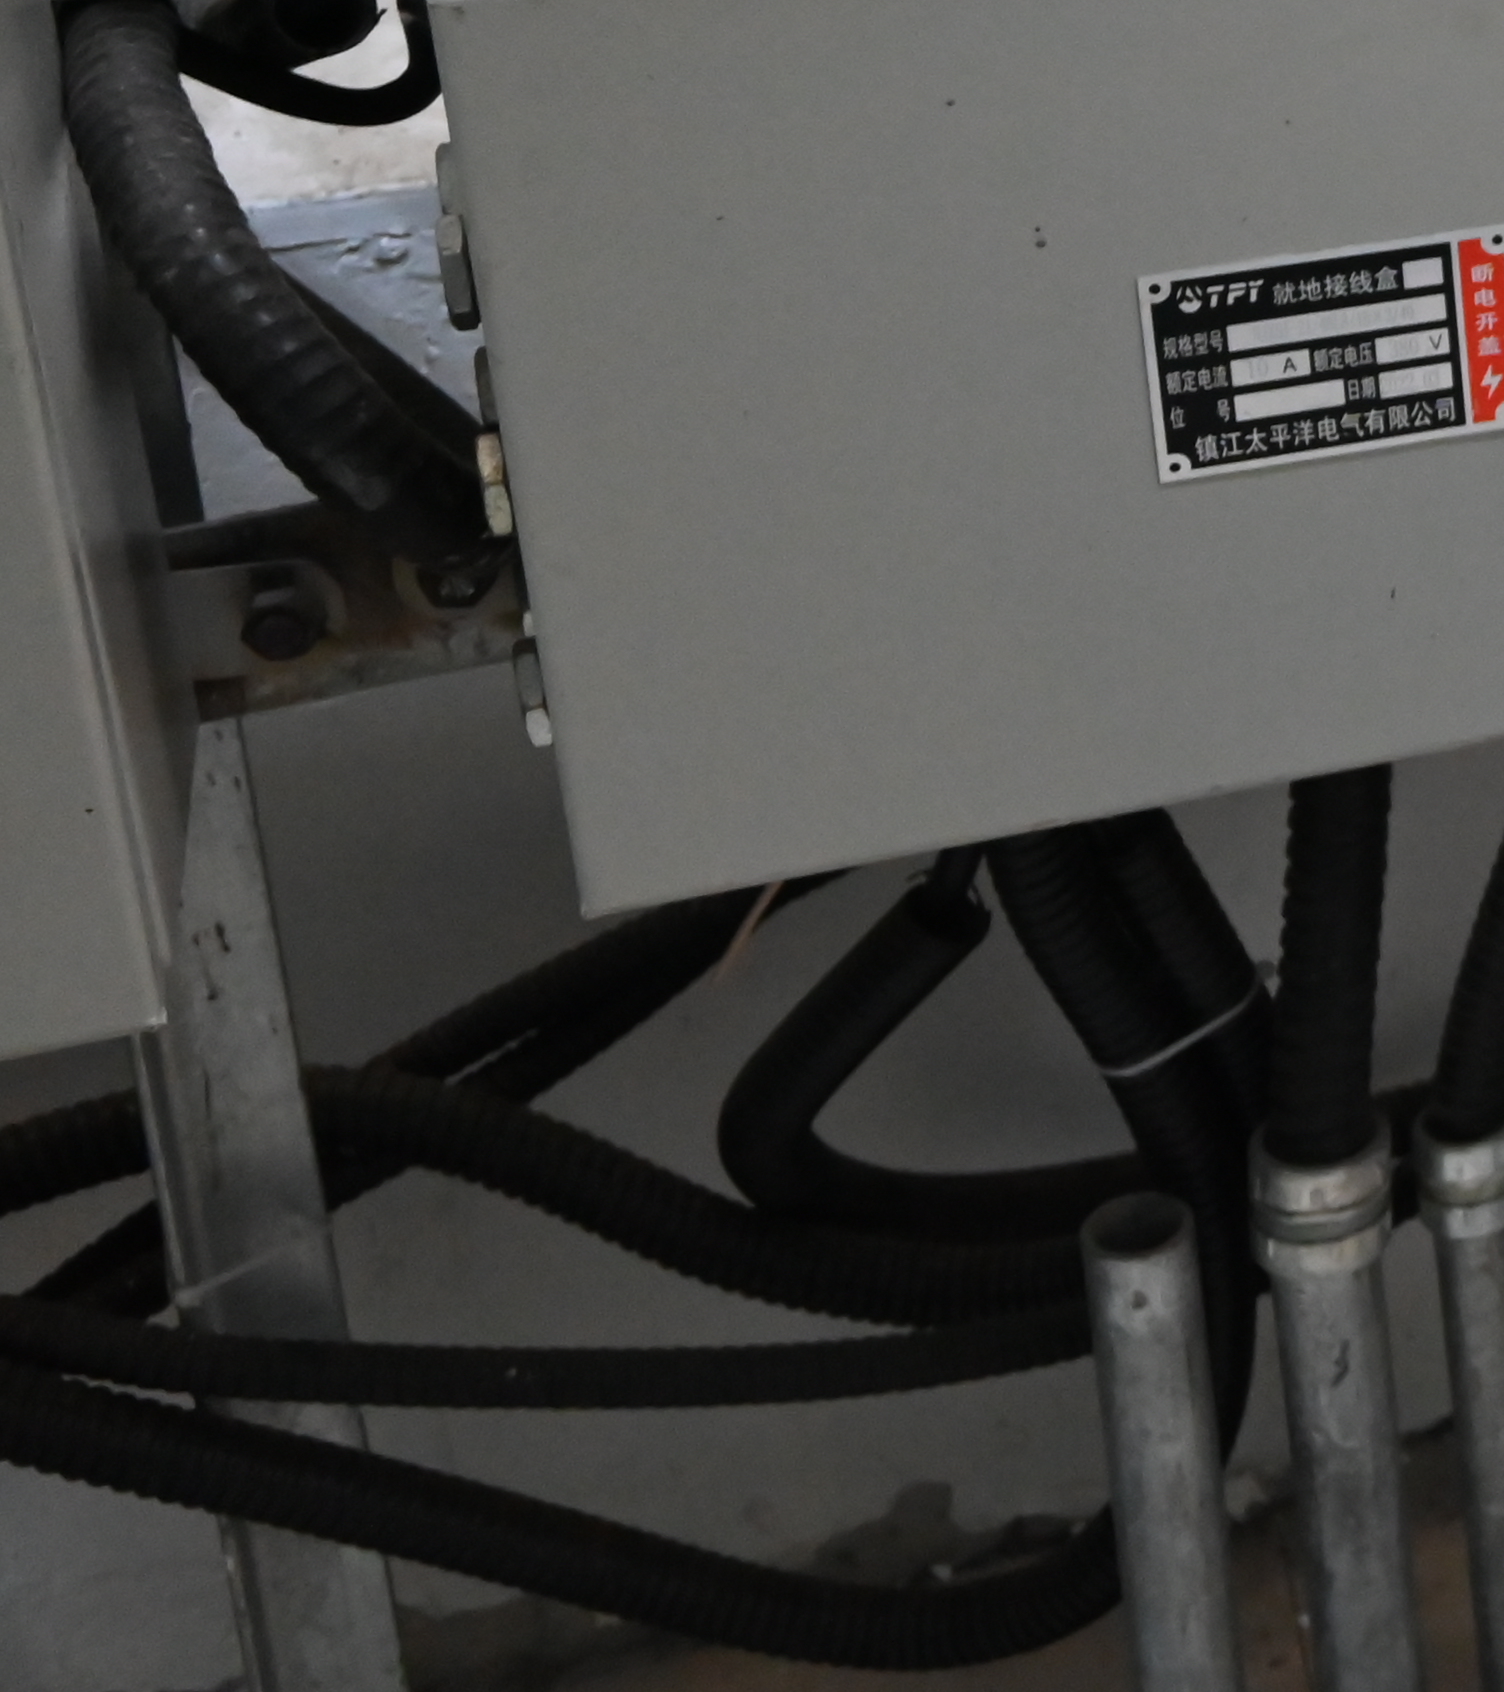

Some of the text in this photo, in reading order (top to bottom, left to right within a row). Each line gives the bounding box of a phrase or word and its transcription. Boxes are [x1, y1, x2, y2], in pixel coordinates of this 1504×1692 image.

[1272, 264, 1399, 306] 就地接线盒
[1470, 261, 1502, 356] 断电开盖
[1162, 329, 1224, 360] 规格型号
[1313, 346, 1375, 373] 额定电压
[1428, 333, 1443, 351] V
[1165, 364, 1229, 395] 额定电流
[1282, 355, 1297, 375] A
[1346, 375, 1378, 401] 日期
[1194, 396, 1458, 463] 镇江太平洋电气有限公司
